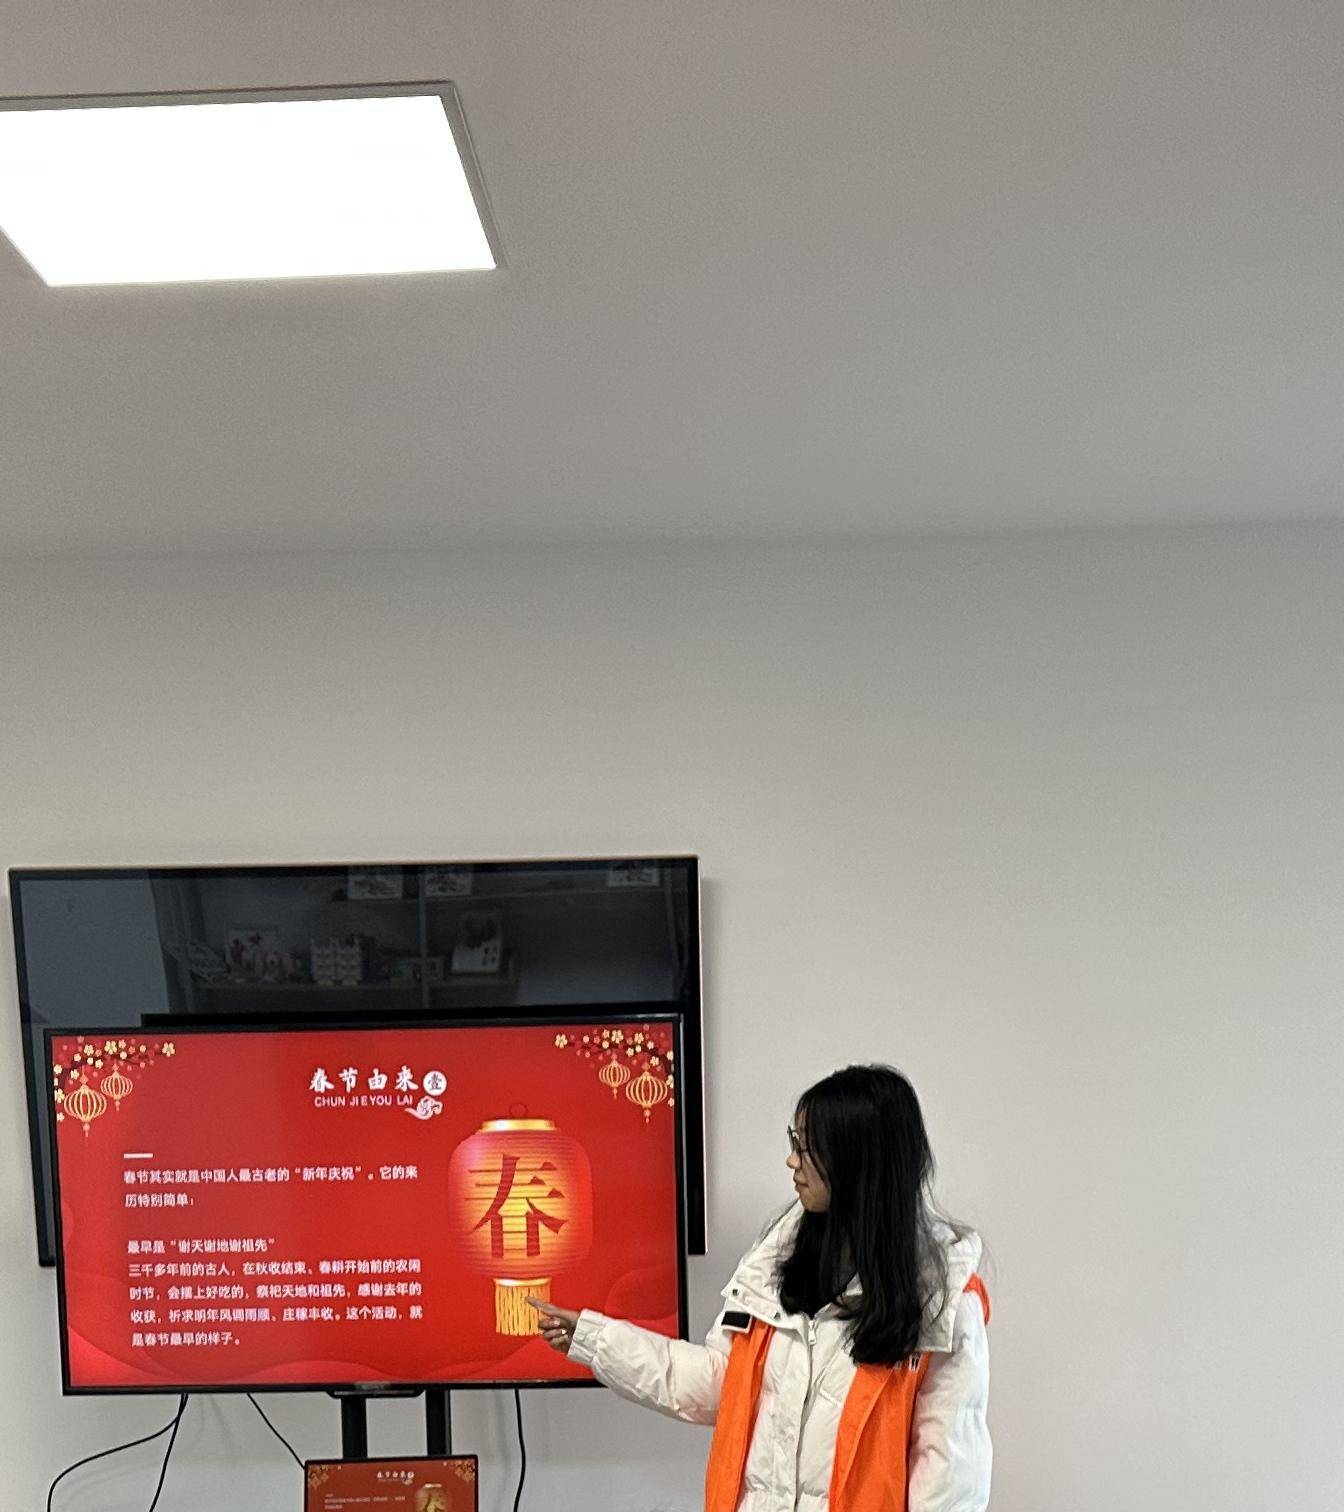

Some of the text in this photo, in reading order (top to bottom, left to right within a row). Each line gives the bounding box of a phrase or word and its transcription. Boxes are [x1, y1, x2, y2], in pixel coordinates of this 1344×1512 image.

[309, 1065, 419, 1093] 春节由来
[314, 1096, 346, 1107] CHUN
[369, 1095, 392, 1106] YOU
[396, 1095, 413, 1105] LAI
[464, 1154, 569, 1257] 春
